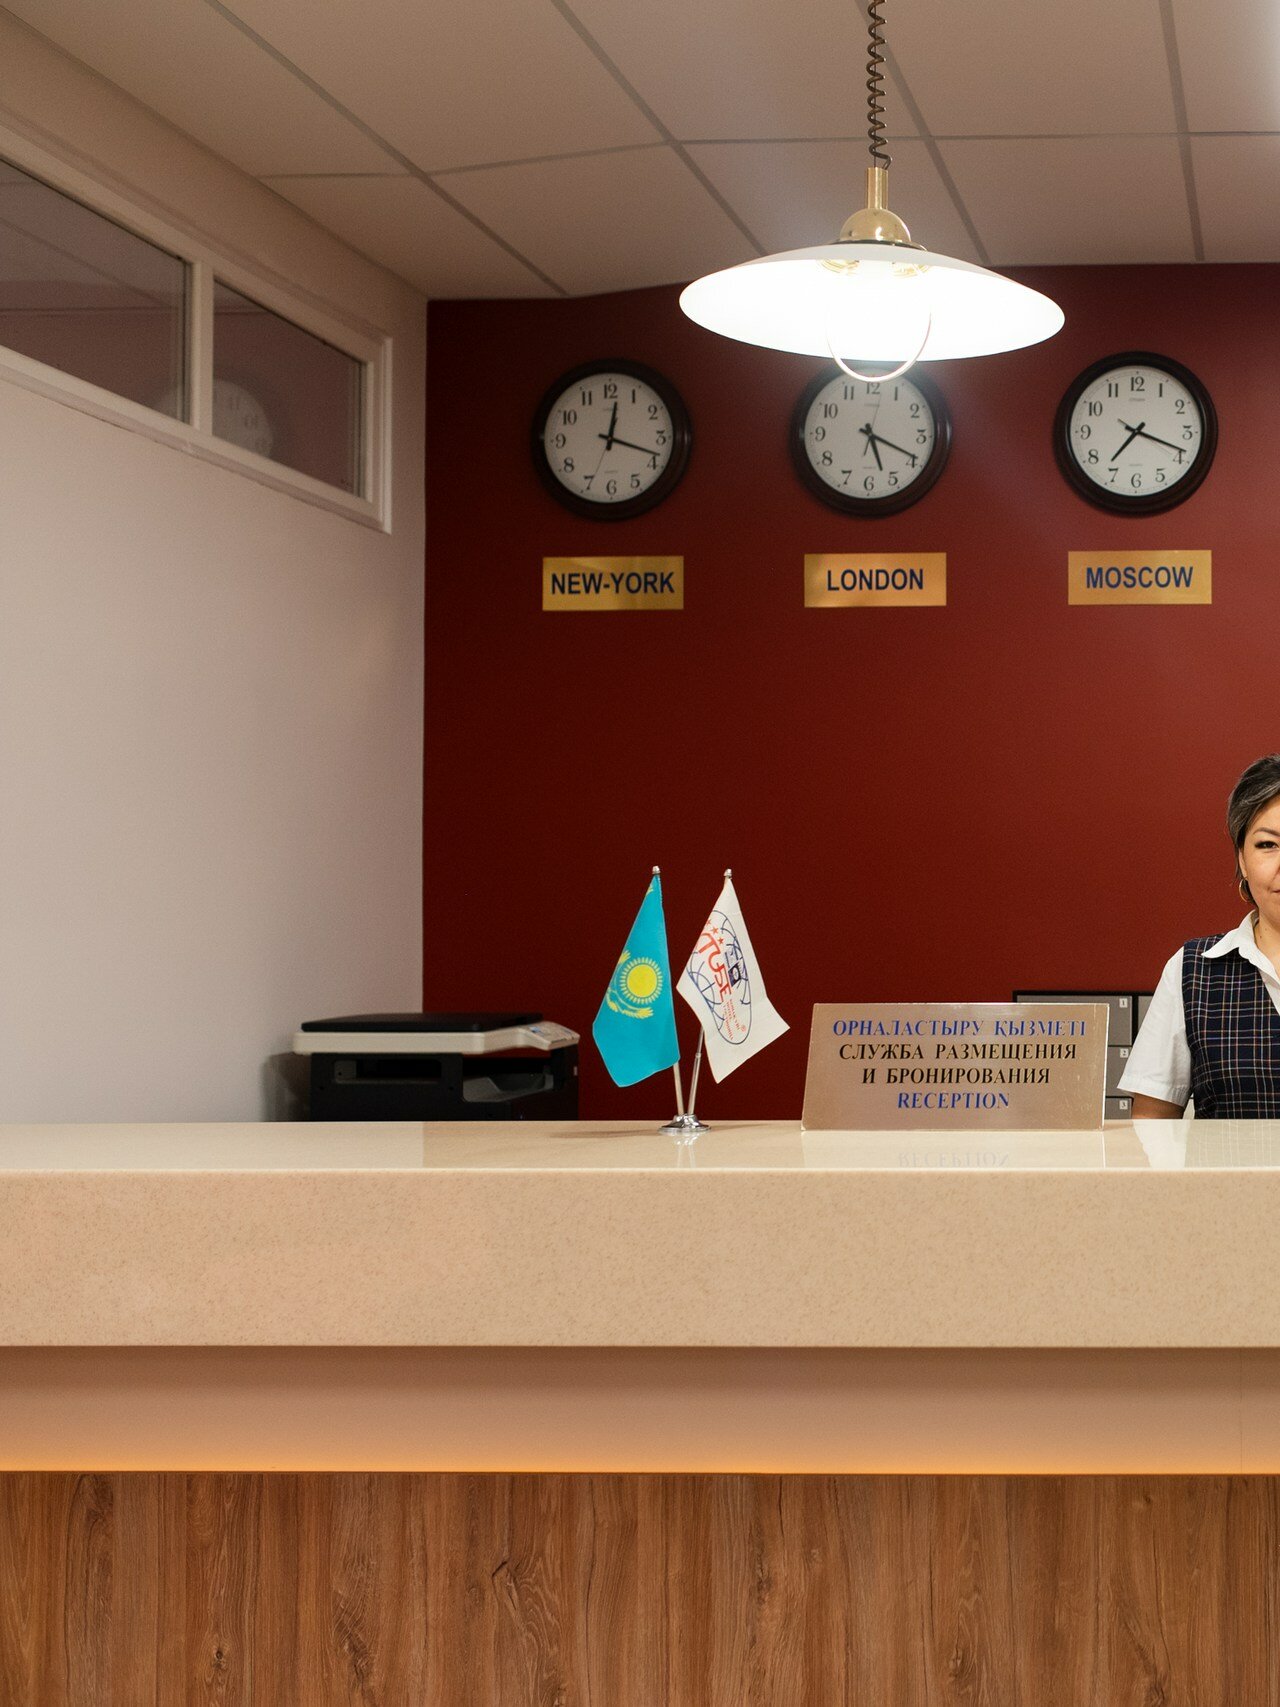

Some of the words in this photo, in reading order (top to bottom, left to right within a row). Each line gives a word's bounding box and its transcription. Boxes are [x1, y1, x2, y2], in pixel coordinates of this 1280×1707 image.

[603, 383, 618, 399] 12
[866, 382, 881, 395] 12
[1108, 383, 1119, 398] 11
[1130, 376, 1145, 392] 12
[582, 391, 592, 406] 11
[844, 385, 855, 400] 11
[648, 405, 658, 420] 2
[824, 403, 838, 419] 10
[910, 403, 920, 419] 2
[1088, 401, 1103, 416] 10
[1175, 399, 1185, 415] 2
[563, 409, 577, 425] 10
[656, 430, 666, 445] 3
[815, 426, 826, 442] 9
[916, 429, 927, 444] 3
[1080, 424, 1091, 440] 9
[1182, 425, 1193, 440] 3
[555, 433, 566, 449] 9
[822, 451, 833, 466] 8
[1088, 449, 1099, 464] 8
[563, 457, 574, 473] 8
[584, 474, 594, 491] 7
[630, 474, 640, 488] 5
[841, 470, 852, 485] 7
[888, 471, 899, 486] 5
[1108, 467, 1119, 482] 7
[1131, 473, 1142, 488] 6
[1155, 468, 1166, 482] 5
[606, 479, 617, 495] 6
[864, 476, 874, 491] 6
[551, 571, 675, 595] NEW-YORK
[827, 568, 924, 592] LONDON
[1086, 566, 1194, 589] MOSCOW
[833, 1019, 984, 1037] ОРНАЛАСТЫРУ
[839, 1043, 924, 1060] СЛУЖБА
[935, 1043, 1077, 1060] РАЗМЕЩЕНИЯ
[862, 1068, 876, 1084] И
[886, 1067, 1050, 1084] БРОНИРОВАНИЯ
[897, 1092, 1010, 1109] RECEPTION
